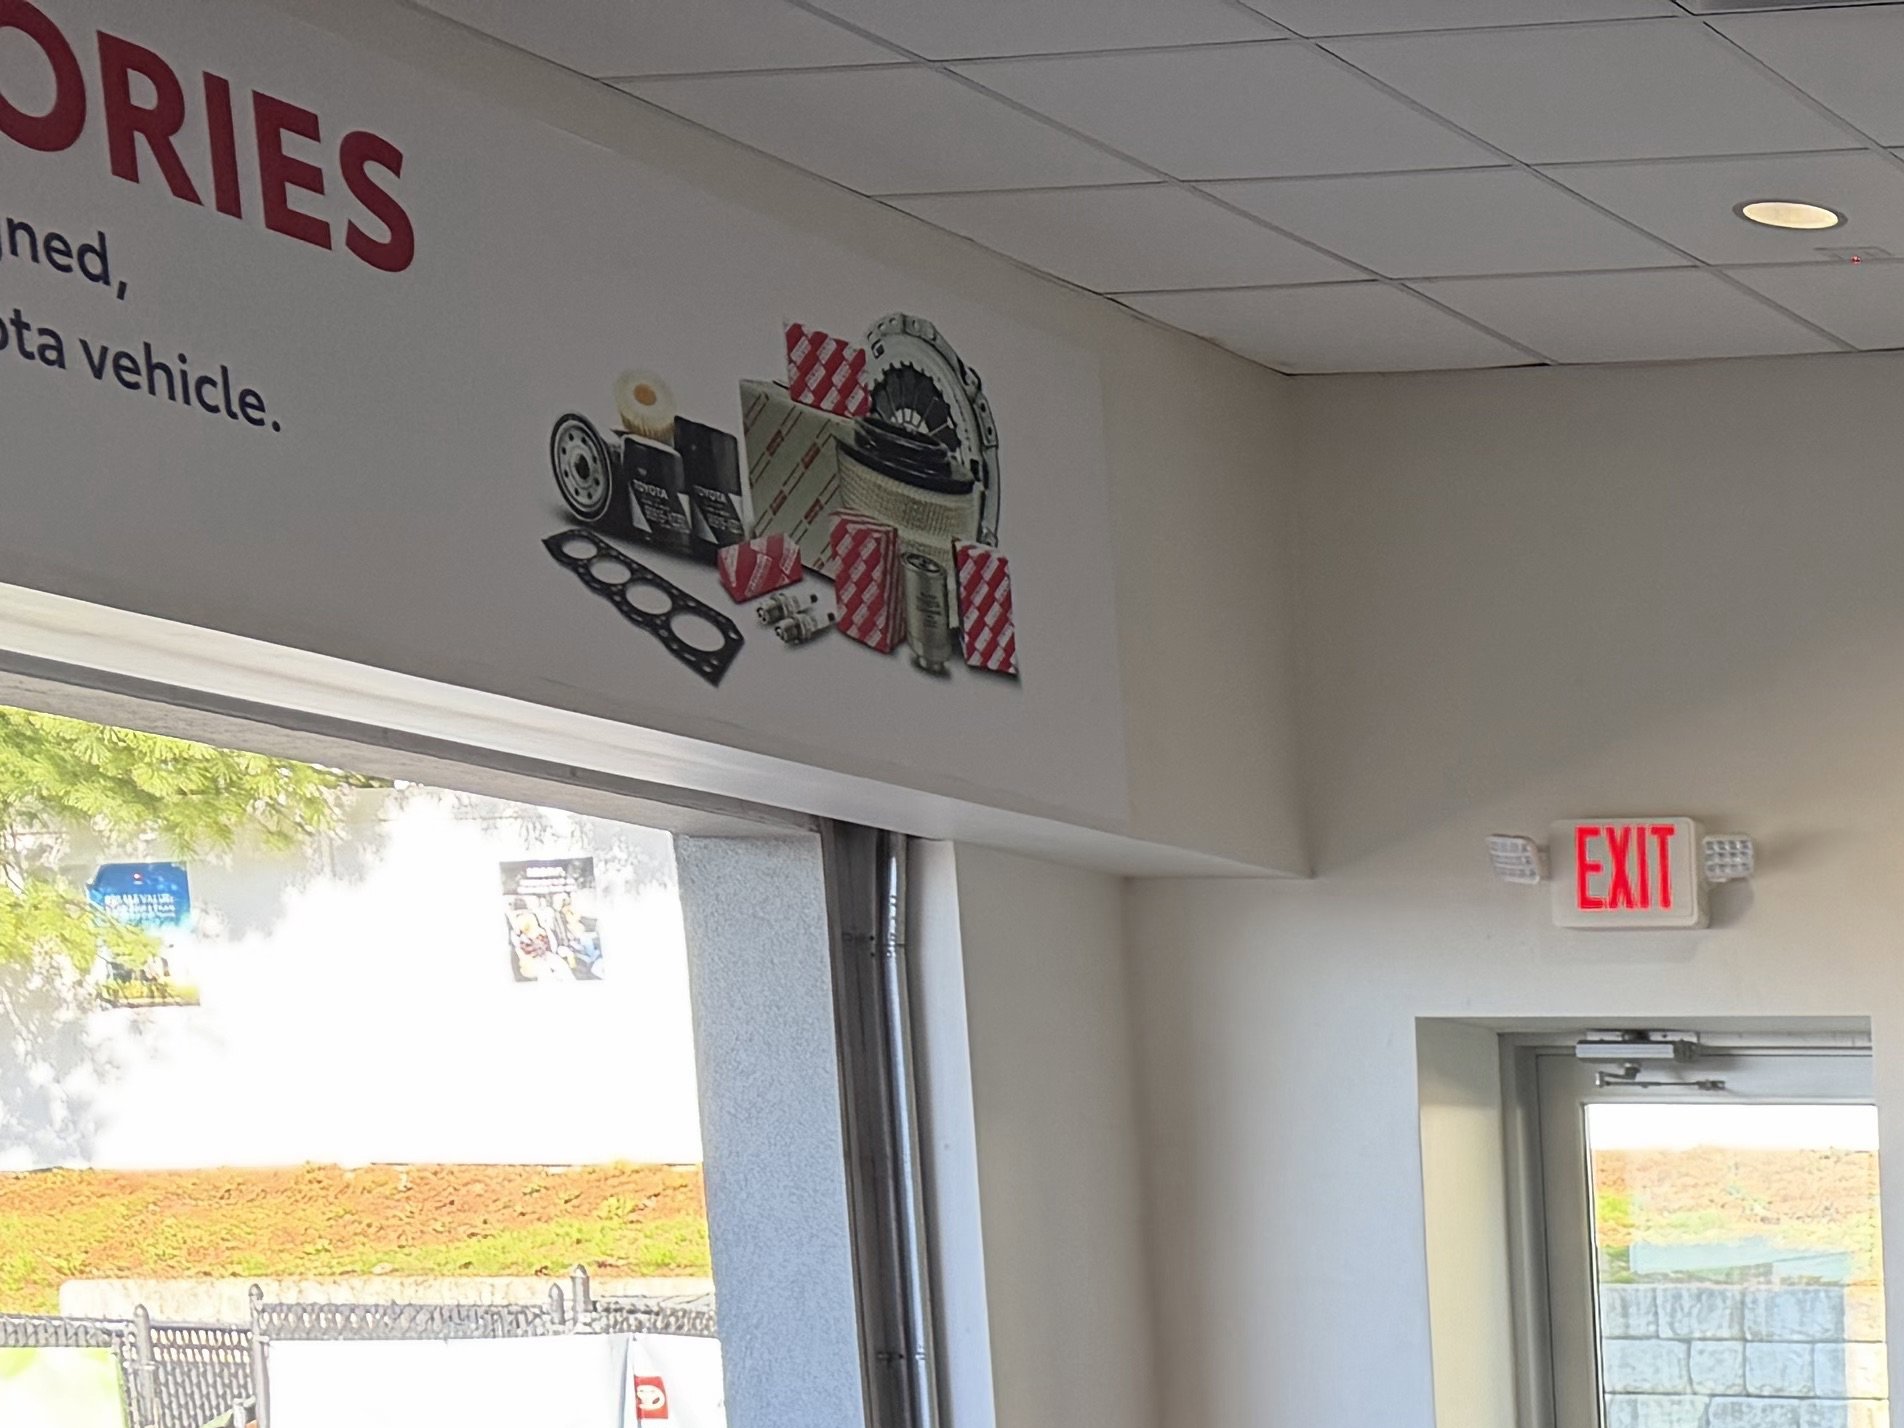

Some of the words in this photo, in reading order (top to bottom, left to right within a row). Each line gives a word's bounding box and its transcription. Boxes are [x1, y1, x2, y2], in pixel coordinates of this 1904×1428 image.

[0, 0, 415, 273] ORIES
[0, 217, 127, 300] ned,
[79, 338, 281, 432] vehicle.
[1575, 824, 1677, 912] EXIT
